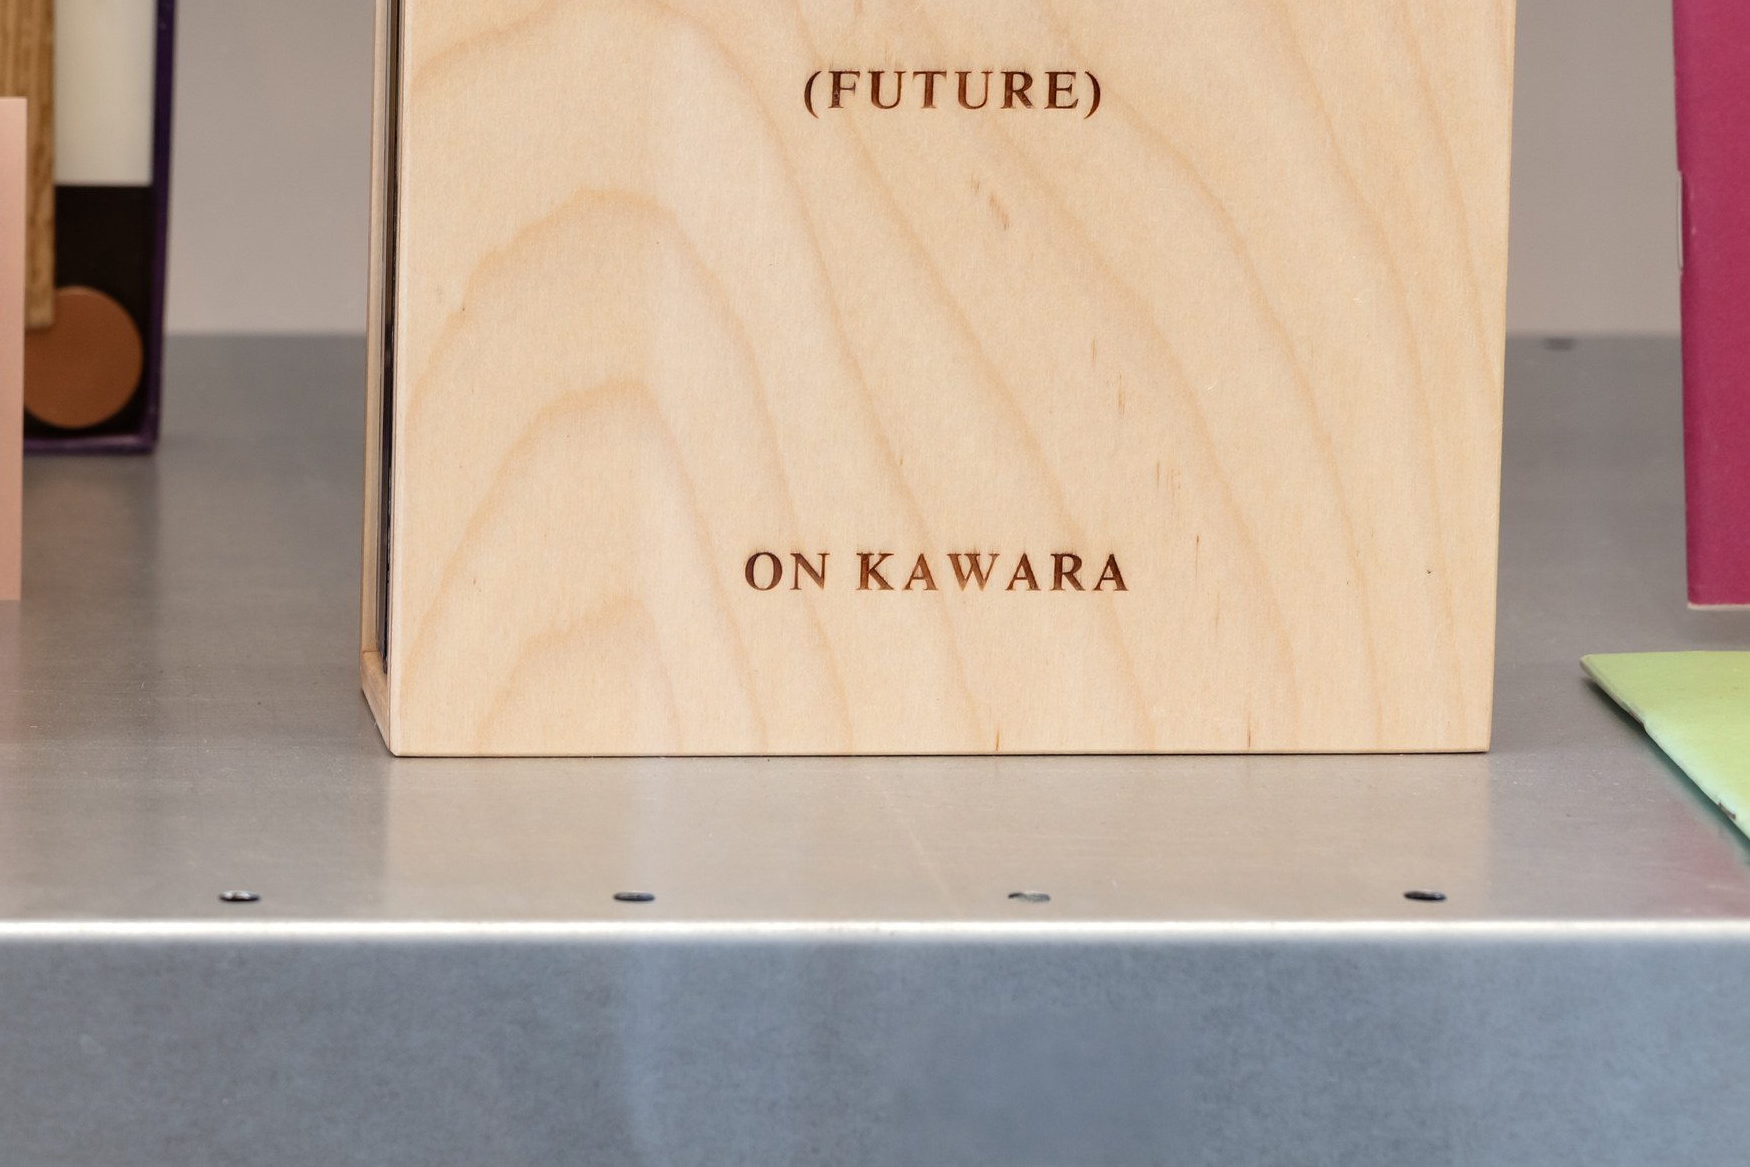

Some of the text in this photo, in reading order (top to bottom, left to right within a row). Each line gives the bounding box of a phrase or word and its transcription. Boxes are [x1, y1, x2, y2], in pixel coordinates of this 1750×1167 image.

[803, 67, 1103, 120] (FUTURE)
[744, 550, 1130, 592] ON KAWARA
